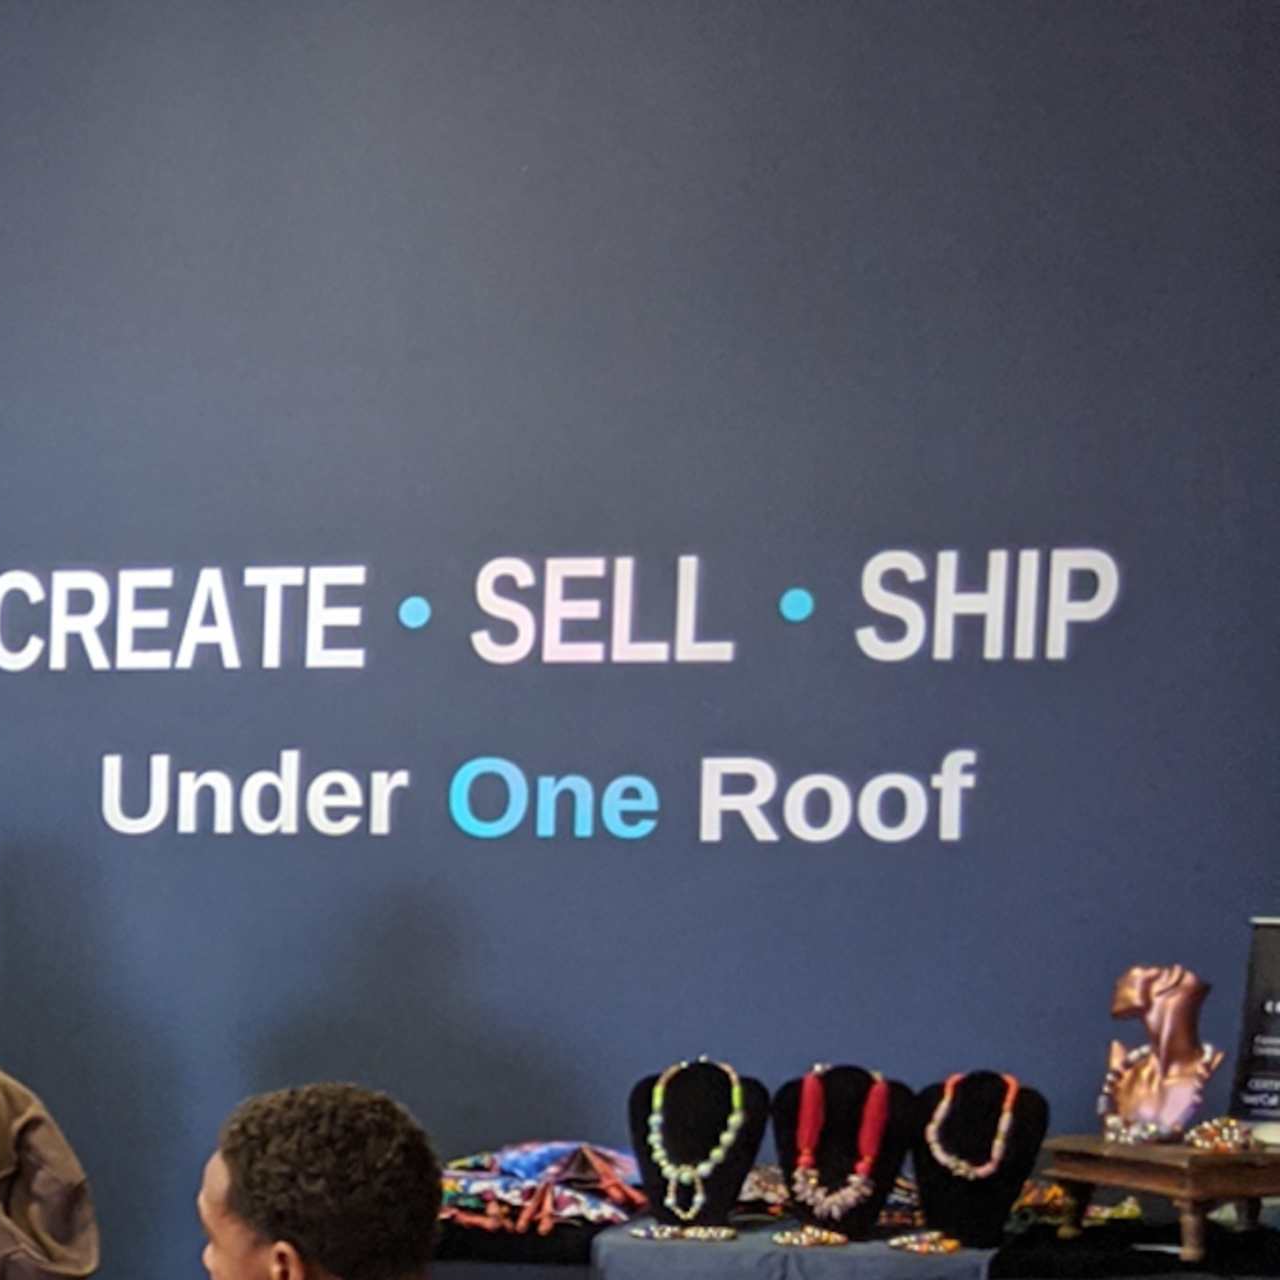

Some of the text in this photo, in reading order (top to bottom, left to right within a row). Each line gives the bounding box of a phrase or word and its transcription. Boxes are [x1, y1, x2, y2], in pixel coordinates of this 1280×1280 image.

[470, 555, 735, 664] SELL
[853, 549, 1120, 662] SHIP
[101, 750, 977, 843] Under One Roof
